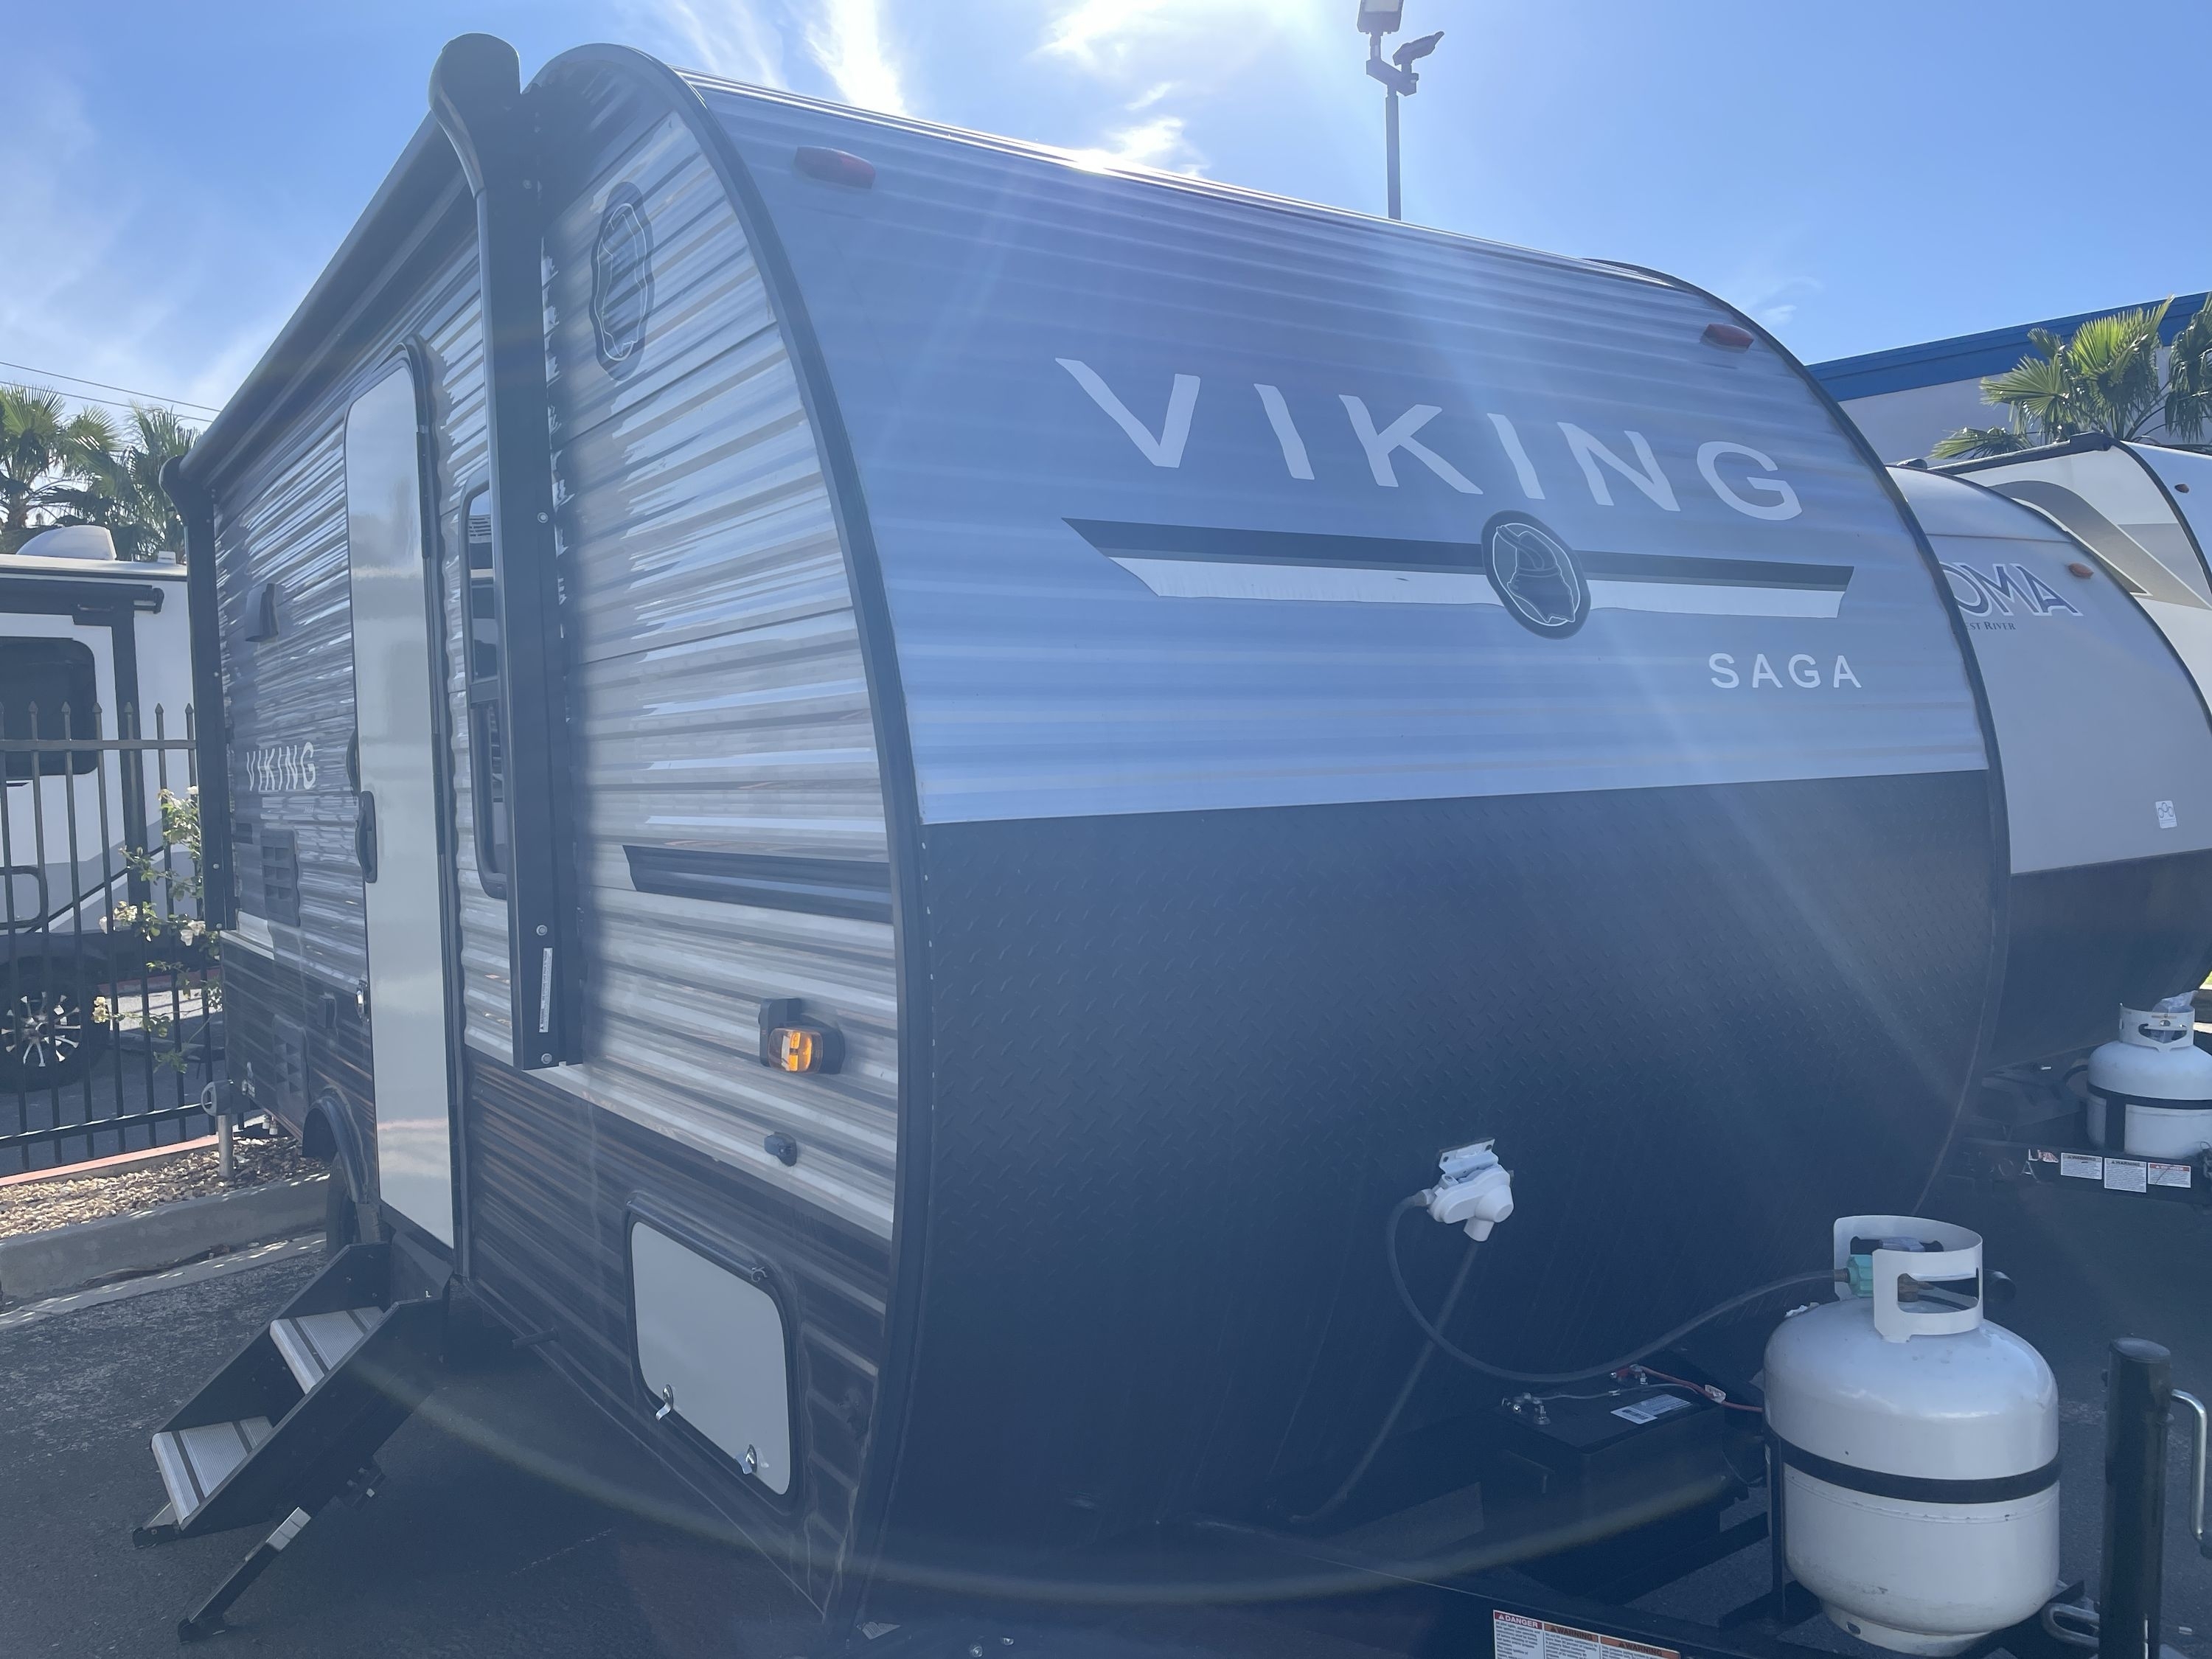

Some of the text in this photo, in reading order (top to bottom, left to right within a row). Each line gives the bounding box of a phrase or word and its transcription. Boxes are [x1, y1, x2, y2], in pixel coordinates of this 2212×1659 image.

[1055, 358, 1802, 521] VIKING
[1708, 653, 1862, 689] SAGA
[246, 741, 316, 791] VIKING
[1505, 1615, 1538, 1628] DANGER
[1557, 1626, 1593, 1641] WARNING
[1625, 1642, 1663, 1657] WARNING
